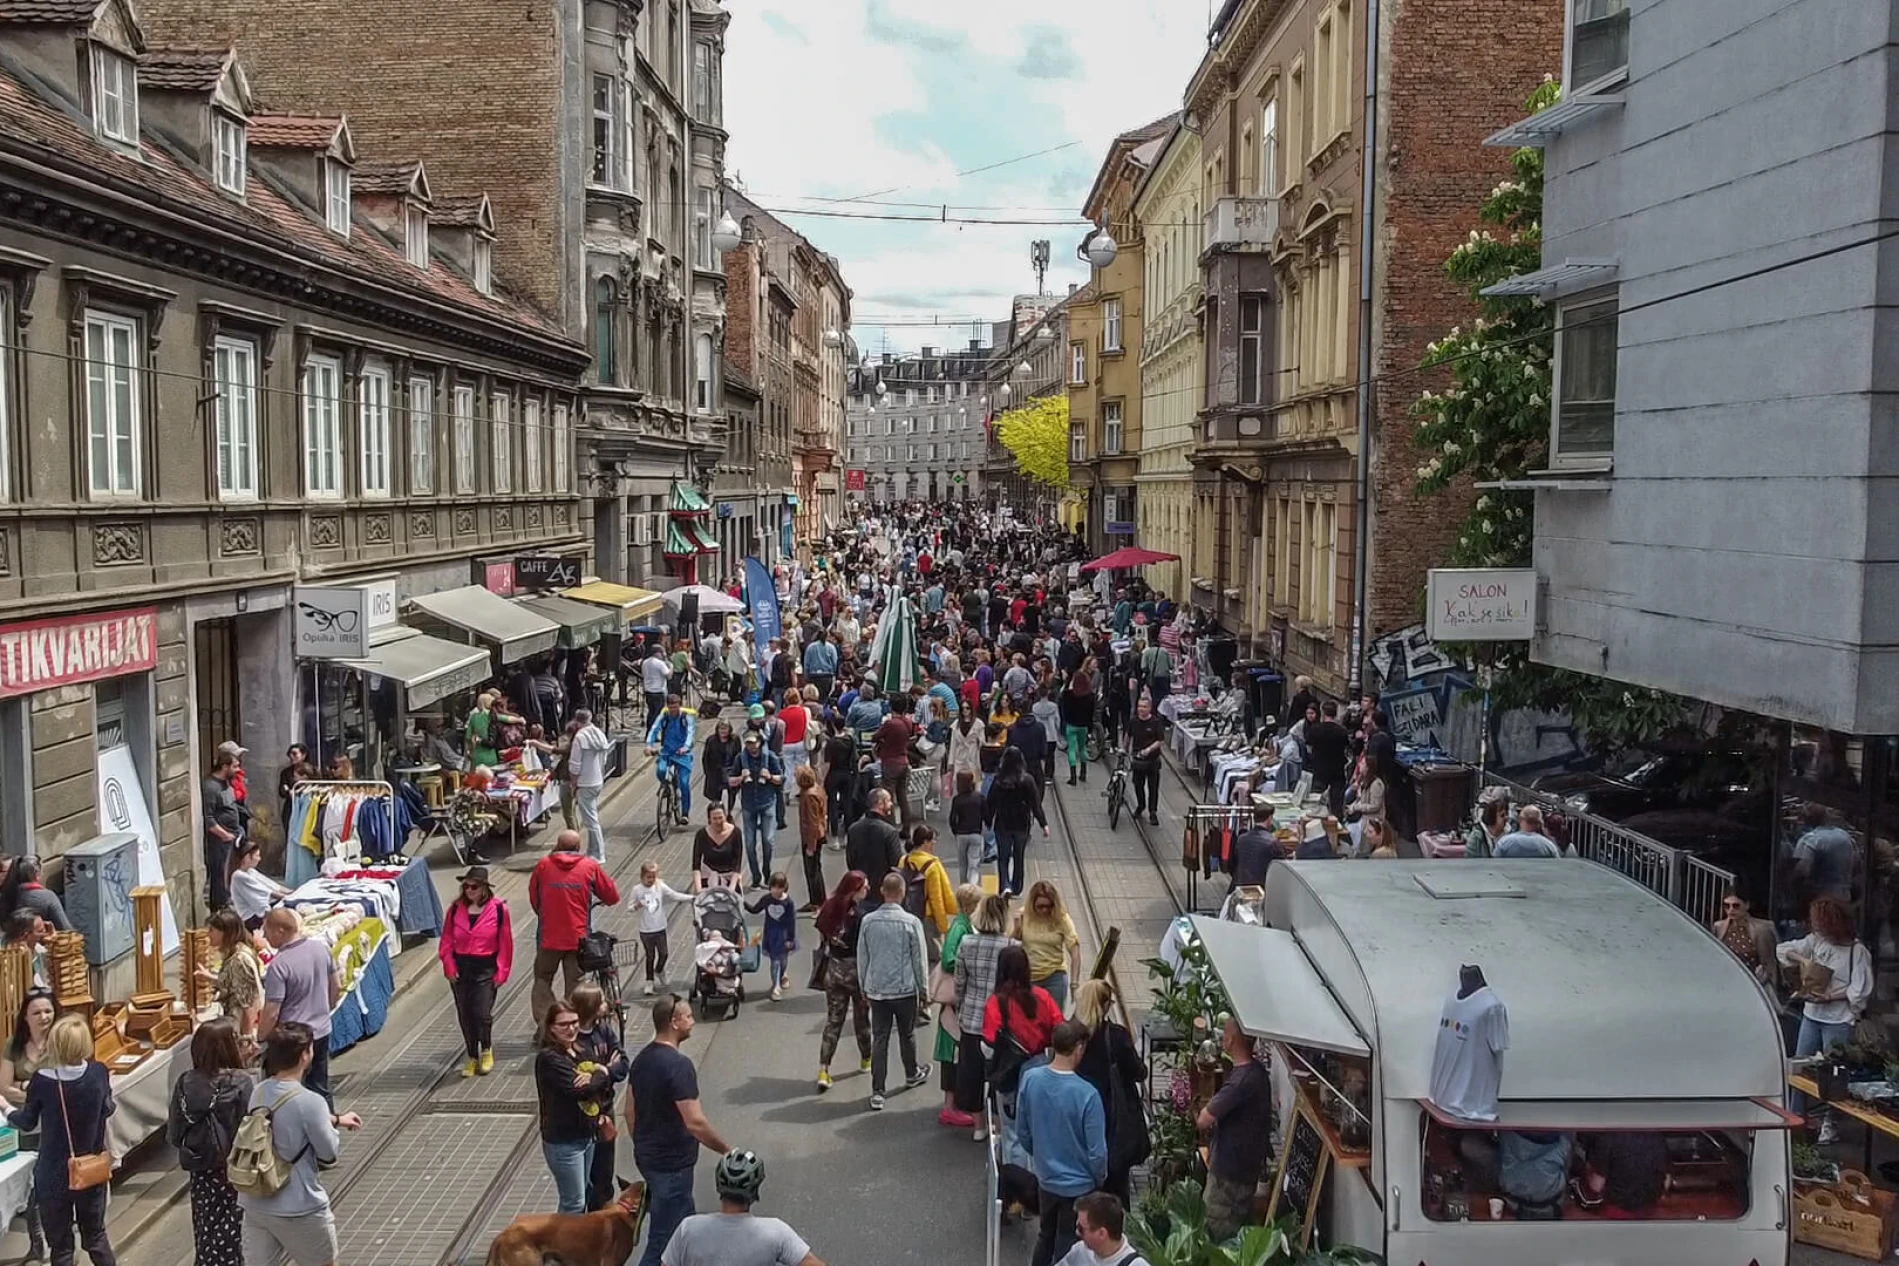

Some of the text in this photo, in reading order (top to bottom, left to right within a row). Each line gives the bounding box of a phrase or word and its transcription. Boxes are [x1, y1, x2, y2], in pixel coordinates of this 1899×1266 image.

[520, 560, 548, 573] CAFFE
[1458, 584, 1507, 599] SALON
[373, 592, 391, 616] IRIS
[0, 613, 152, 686] TIKVARIJAT
